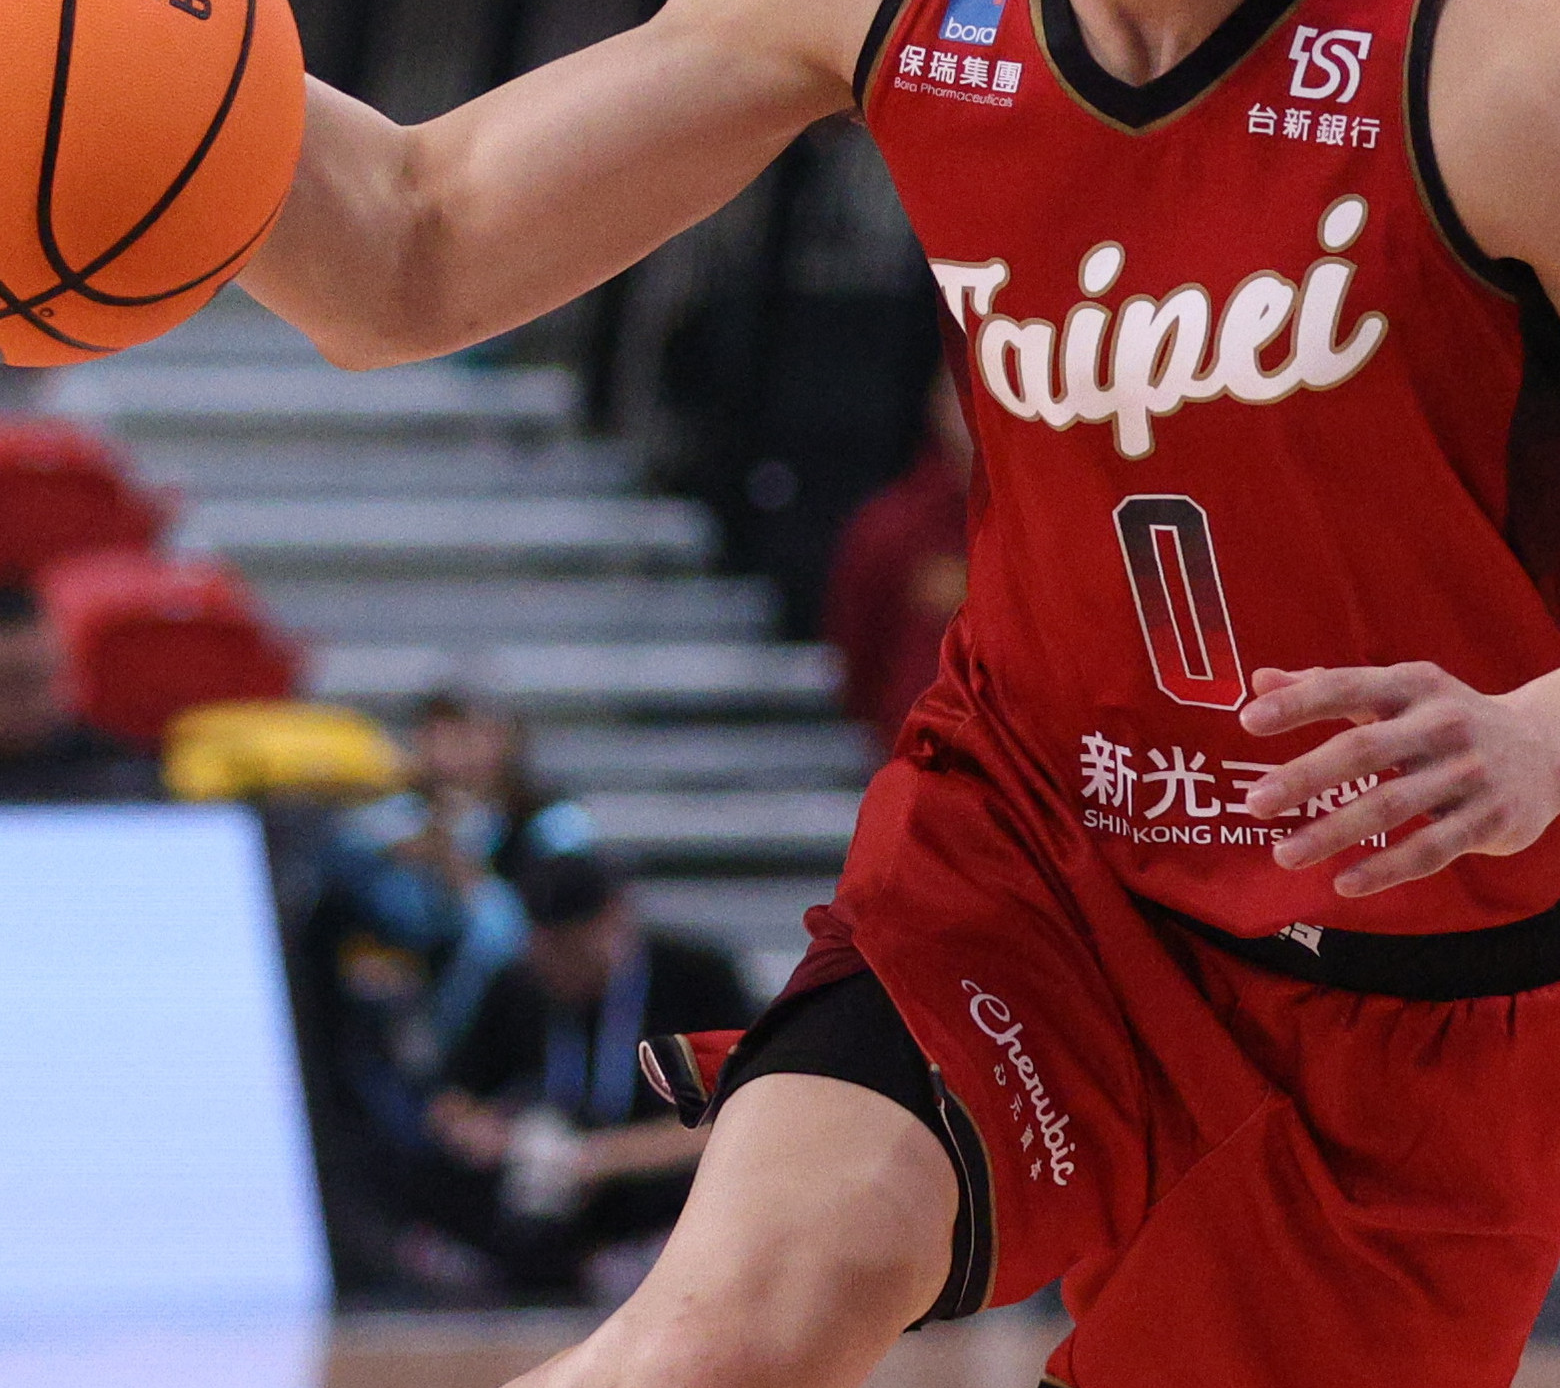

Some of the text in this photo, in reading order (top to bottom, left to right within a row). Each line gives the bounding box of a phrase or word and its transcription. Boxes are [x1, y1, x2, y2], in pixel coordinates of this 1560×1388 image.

[944, 16, 997, 44] bora
[898, 44, 1023, 94] 保瑞集團
[1247, 102, 1380, 149] 台新銀行
[928, 193, 1389, 460] Taipei
[1112, 493, 1248, 712] 0
[1079, 730, 1380, 819] 新光三
[1132, 825, 1212, 845] KONG
[1219, 825, 1388, 849] MITSHI
[960, 978, 1076, 1187] Cherubic
